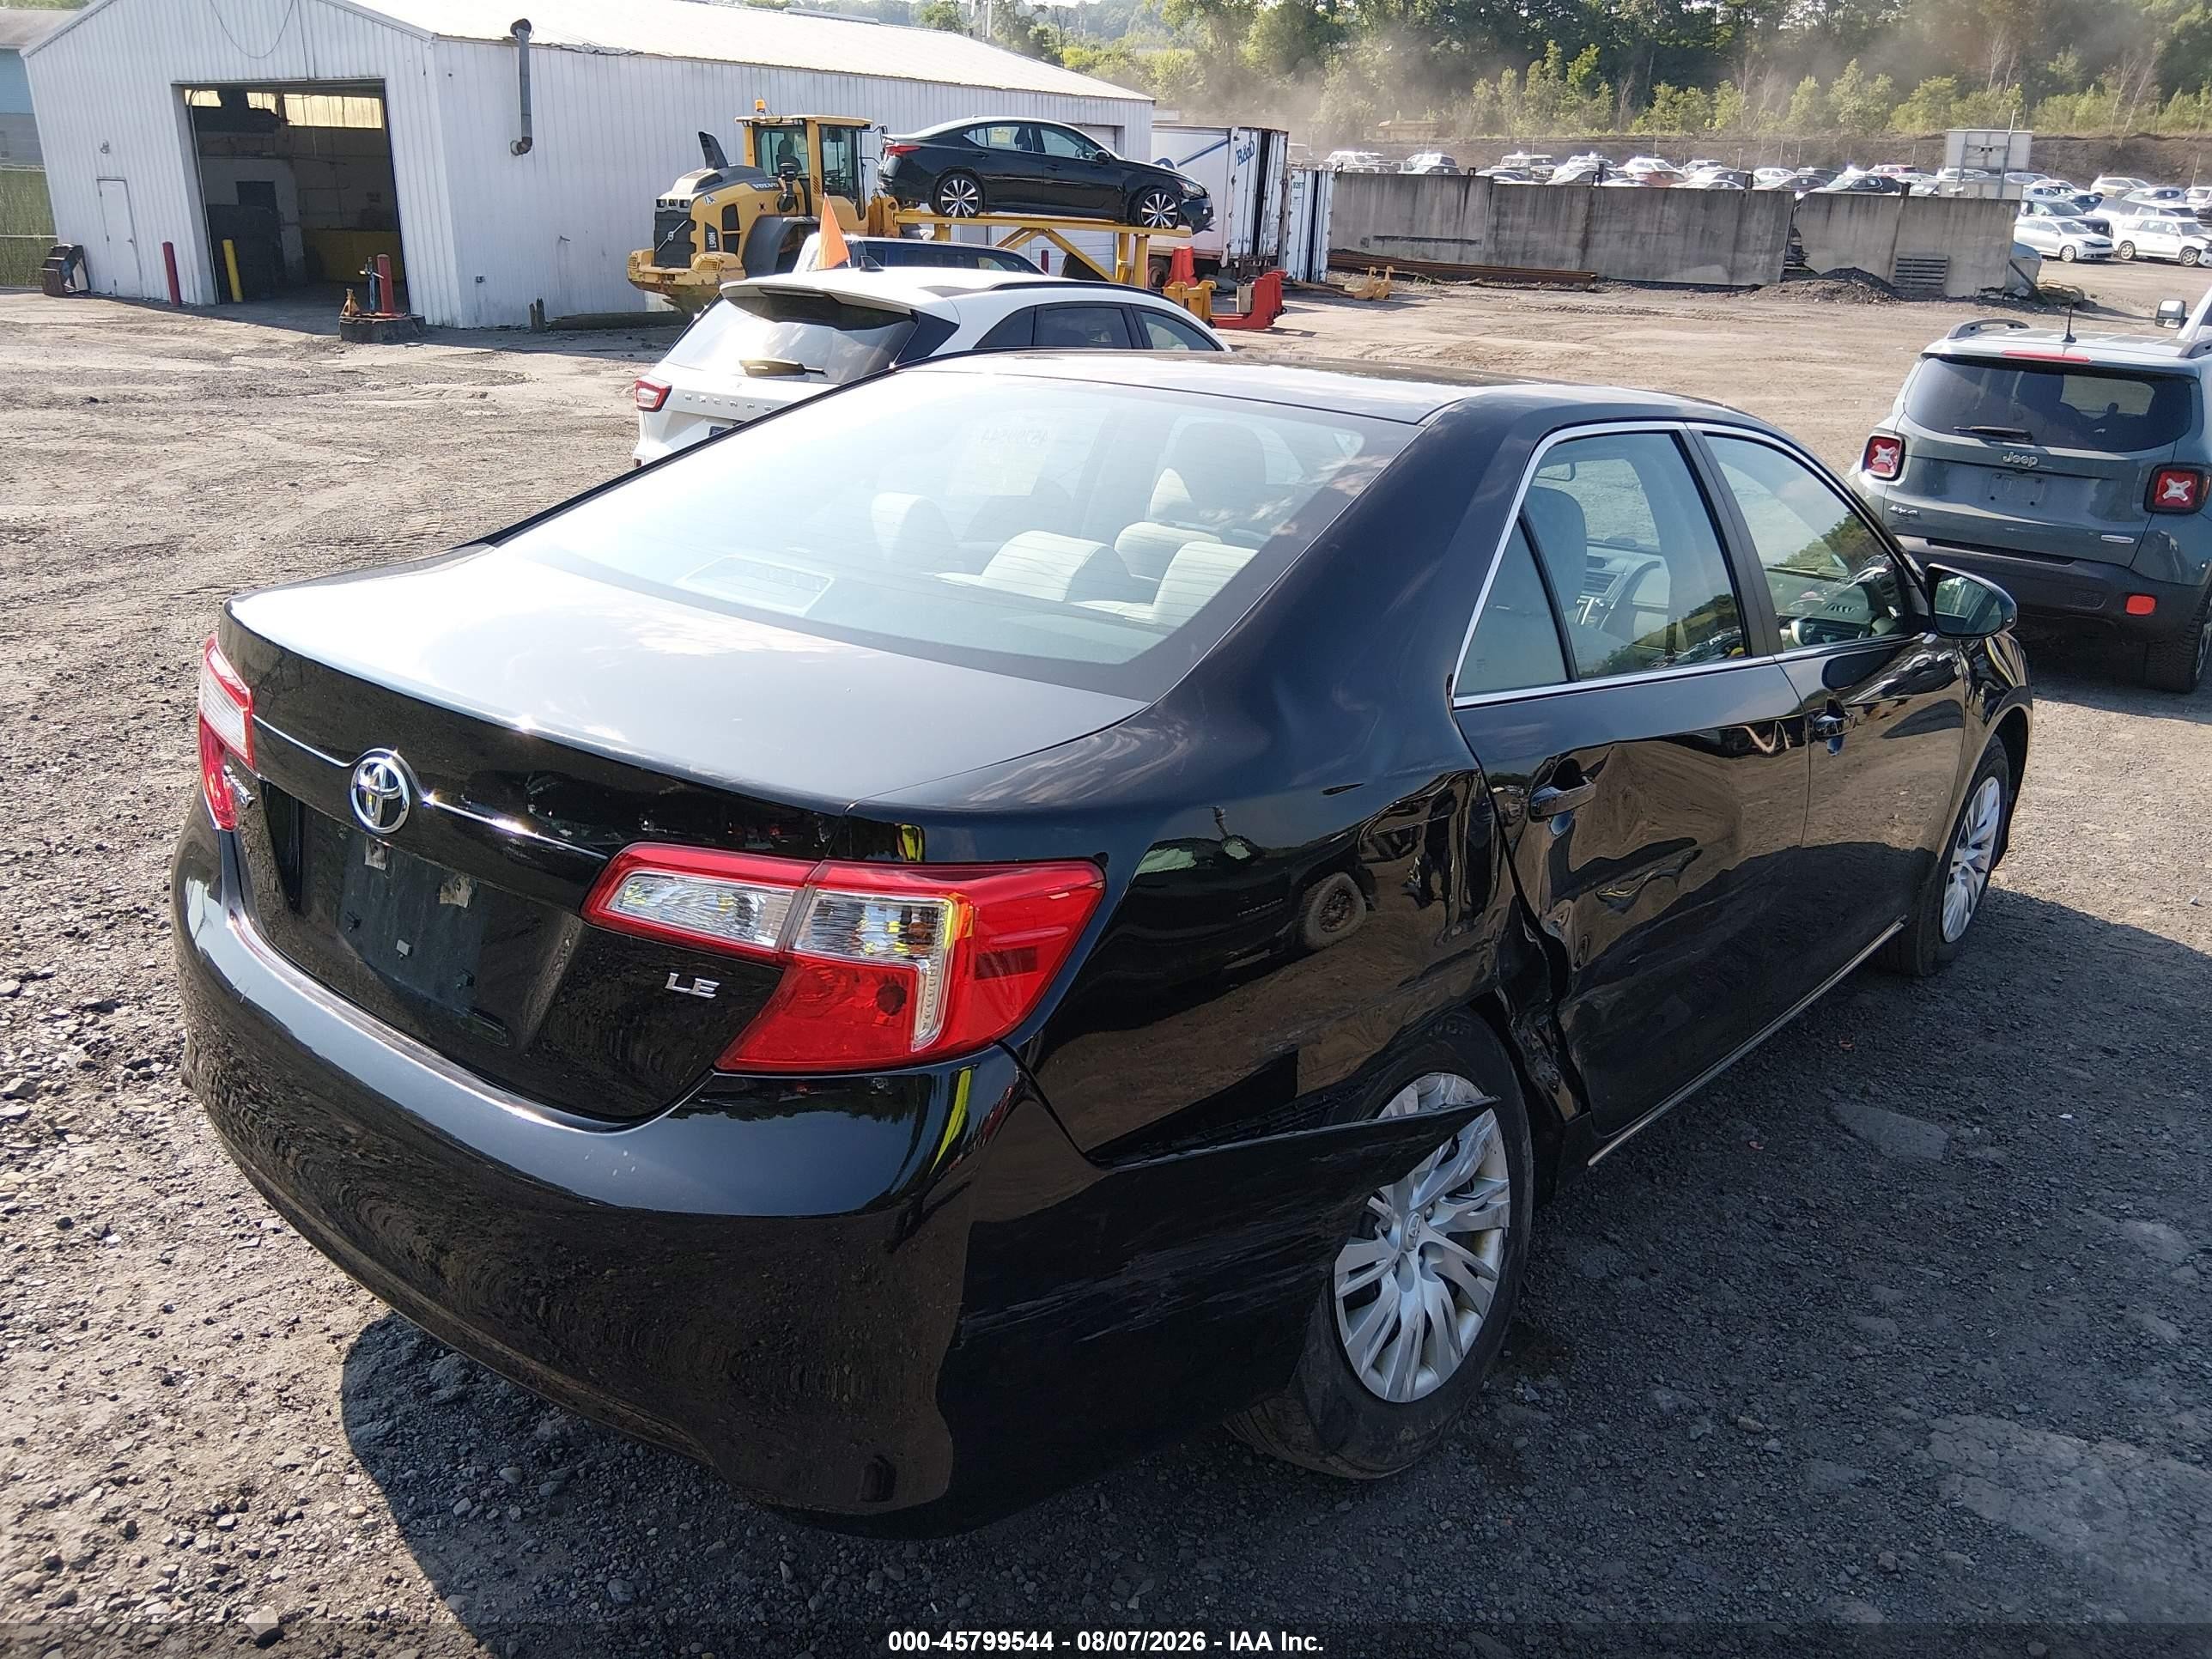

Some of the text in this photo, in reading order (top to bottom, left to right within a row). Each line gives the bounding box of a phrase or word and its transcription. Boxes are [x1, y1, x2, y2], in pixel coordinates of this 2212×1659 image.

[708, 232, 717, 247] L90H
[2002, 451, 2039, 468] Jeep
[665, 972, 720, 999] LE
